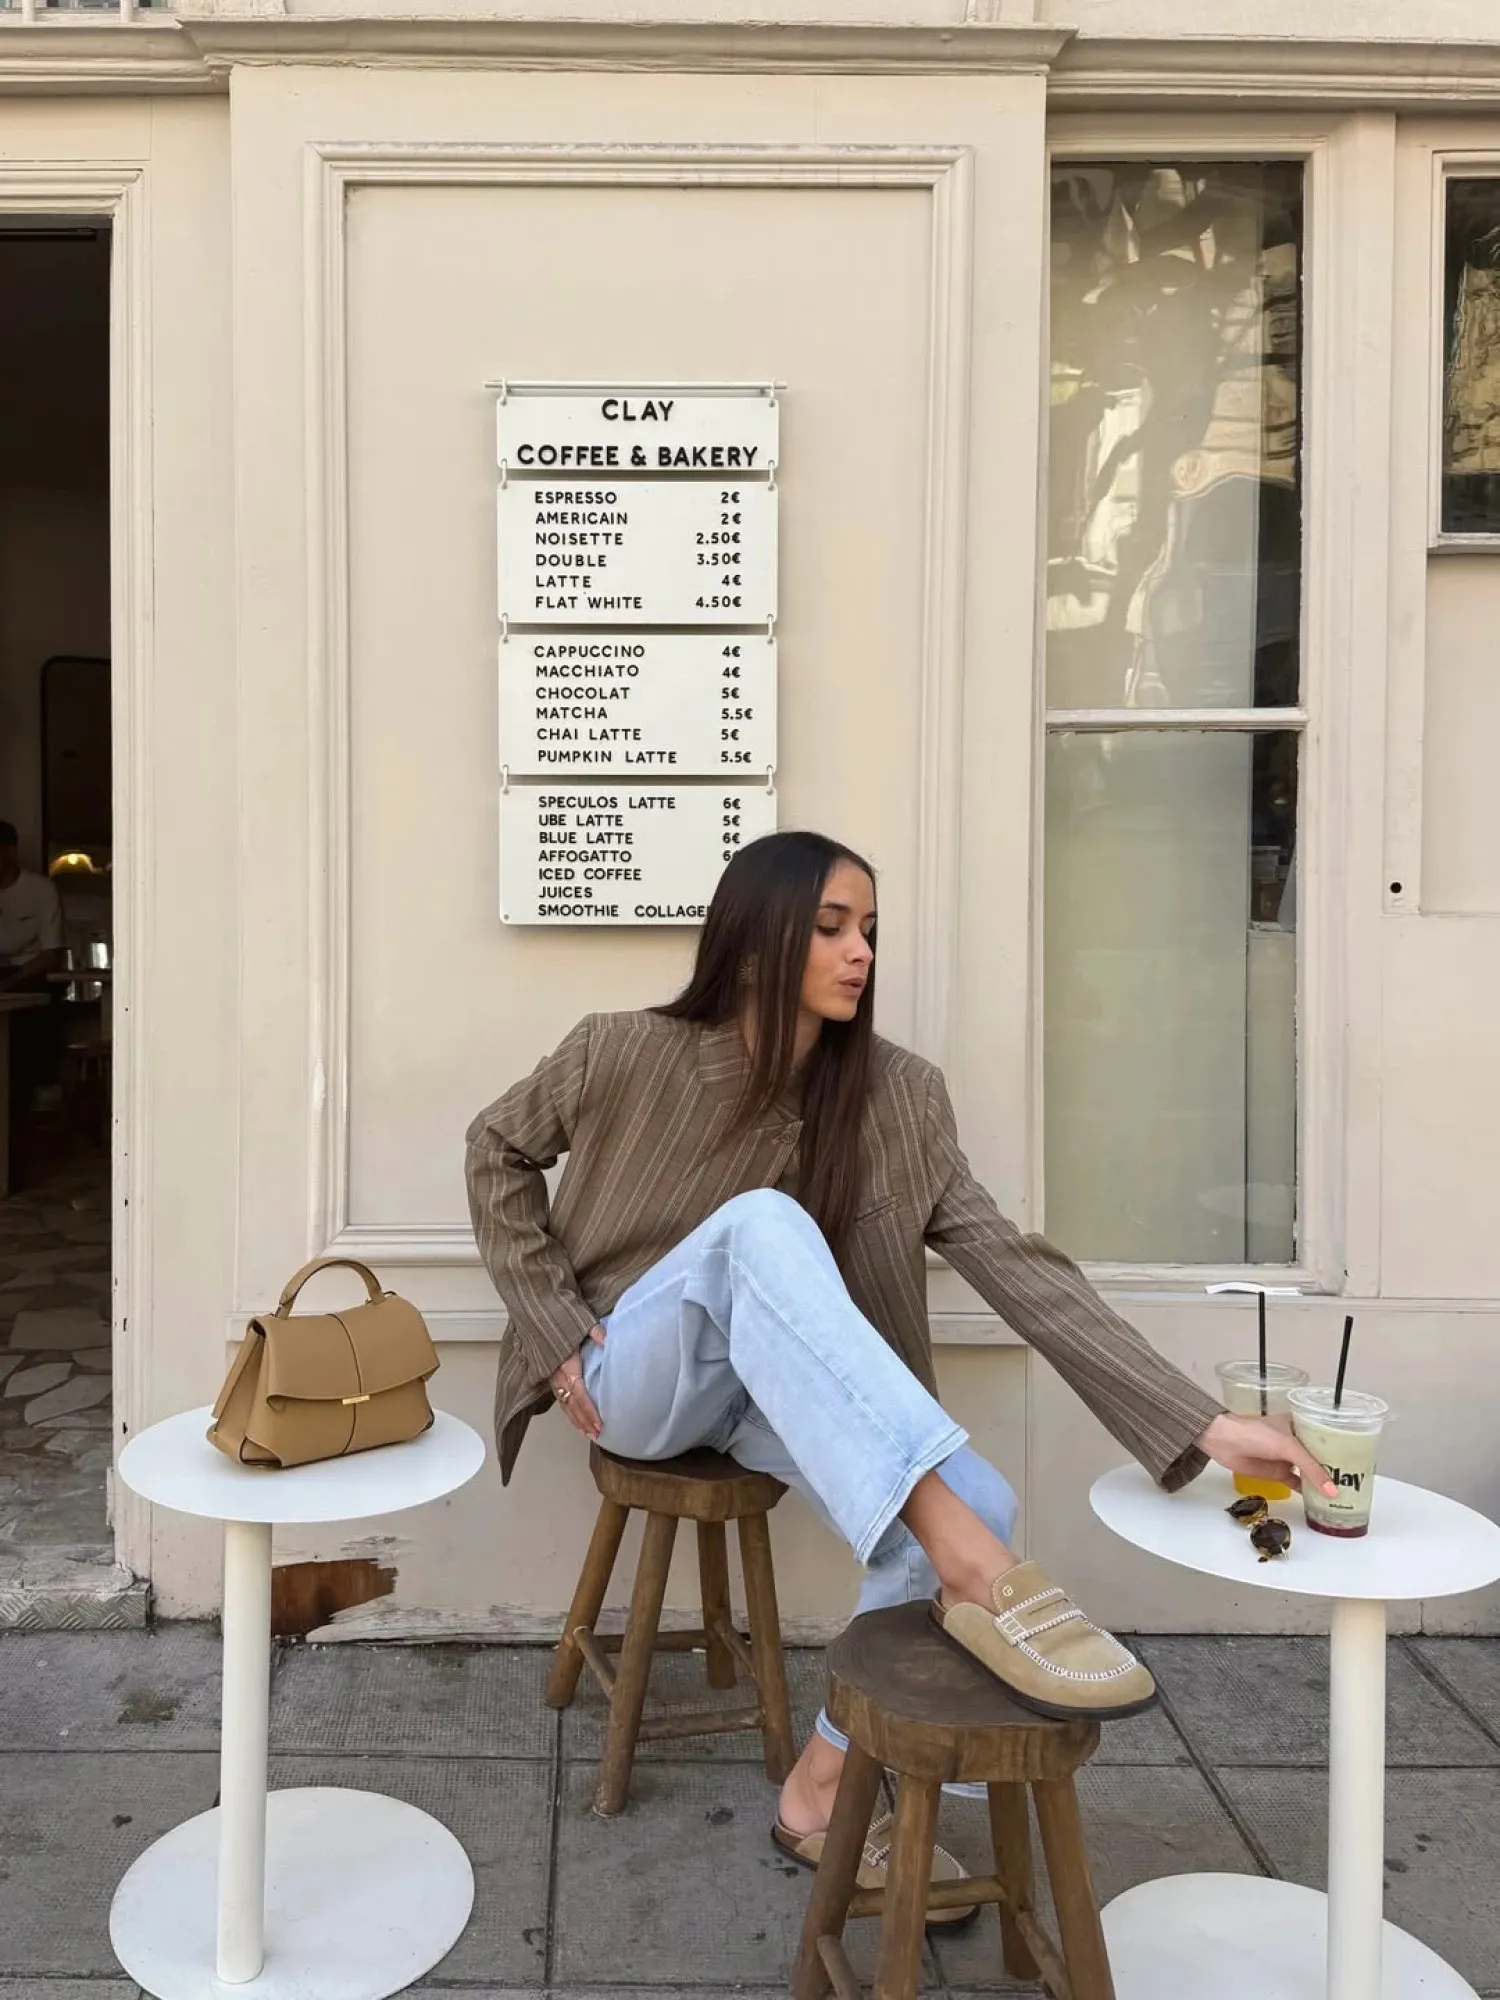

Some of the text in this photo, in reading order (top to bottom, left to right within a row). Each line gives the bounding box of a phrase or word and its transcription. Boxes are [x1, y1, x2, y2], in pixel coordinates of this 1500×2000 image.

[601, 398, 674, 422] CLAY
[517, 443, 758, 468] COFFEE & BAKERY
[534, 491, 740, 505] ESPRESSO 2€
[535, 511, 742, 526] AMERICAIN 2€
[535, 531, 741, 546] NOISETTE 2.50€
[535, 552, 741, 568] DOUBLE 3.50€
[535, 574, 742, 589] LATTE 4€
[535, 595, 742, 610] FLAT WHITE 4.50€
[533, 644, 741, 658] CAPPUCCINO 4€
[535, 664, 741, 679] MACCHIATO 4€
[535, 686, 740, 700] CHOCOLAT 5€
[536, 706, 753, 721] MATCHA 5.5€
[536, 727, 740, 741] CHAI LATTE 5€
[538, 749, 752, 764] PUMPKIN LATTE 5.5€
[538, 795, 741, 811] SPECULOS LATTE 6€
[538, 813, 741, 827] UBE LATTE 5€
[539, 831, 741, 845] BLUE LATTE 6€
[538, 849, 737, 863] AFFOGATTO 6
[538, 867, 642, 881] ICED COFFEE
[538, 885, 593, 899] JUICES
[538, 903, 619, 918] SMOOTHIE
